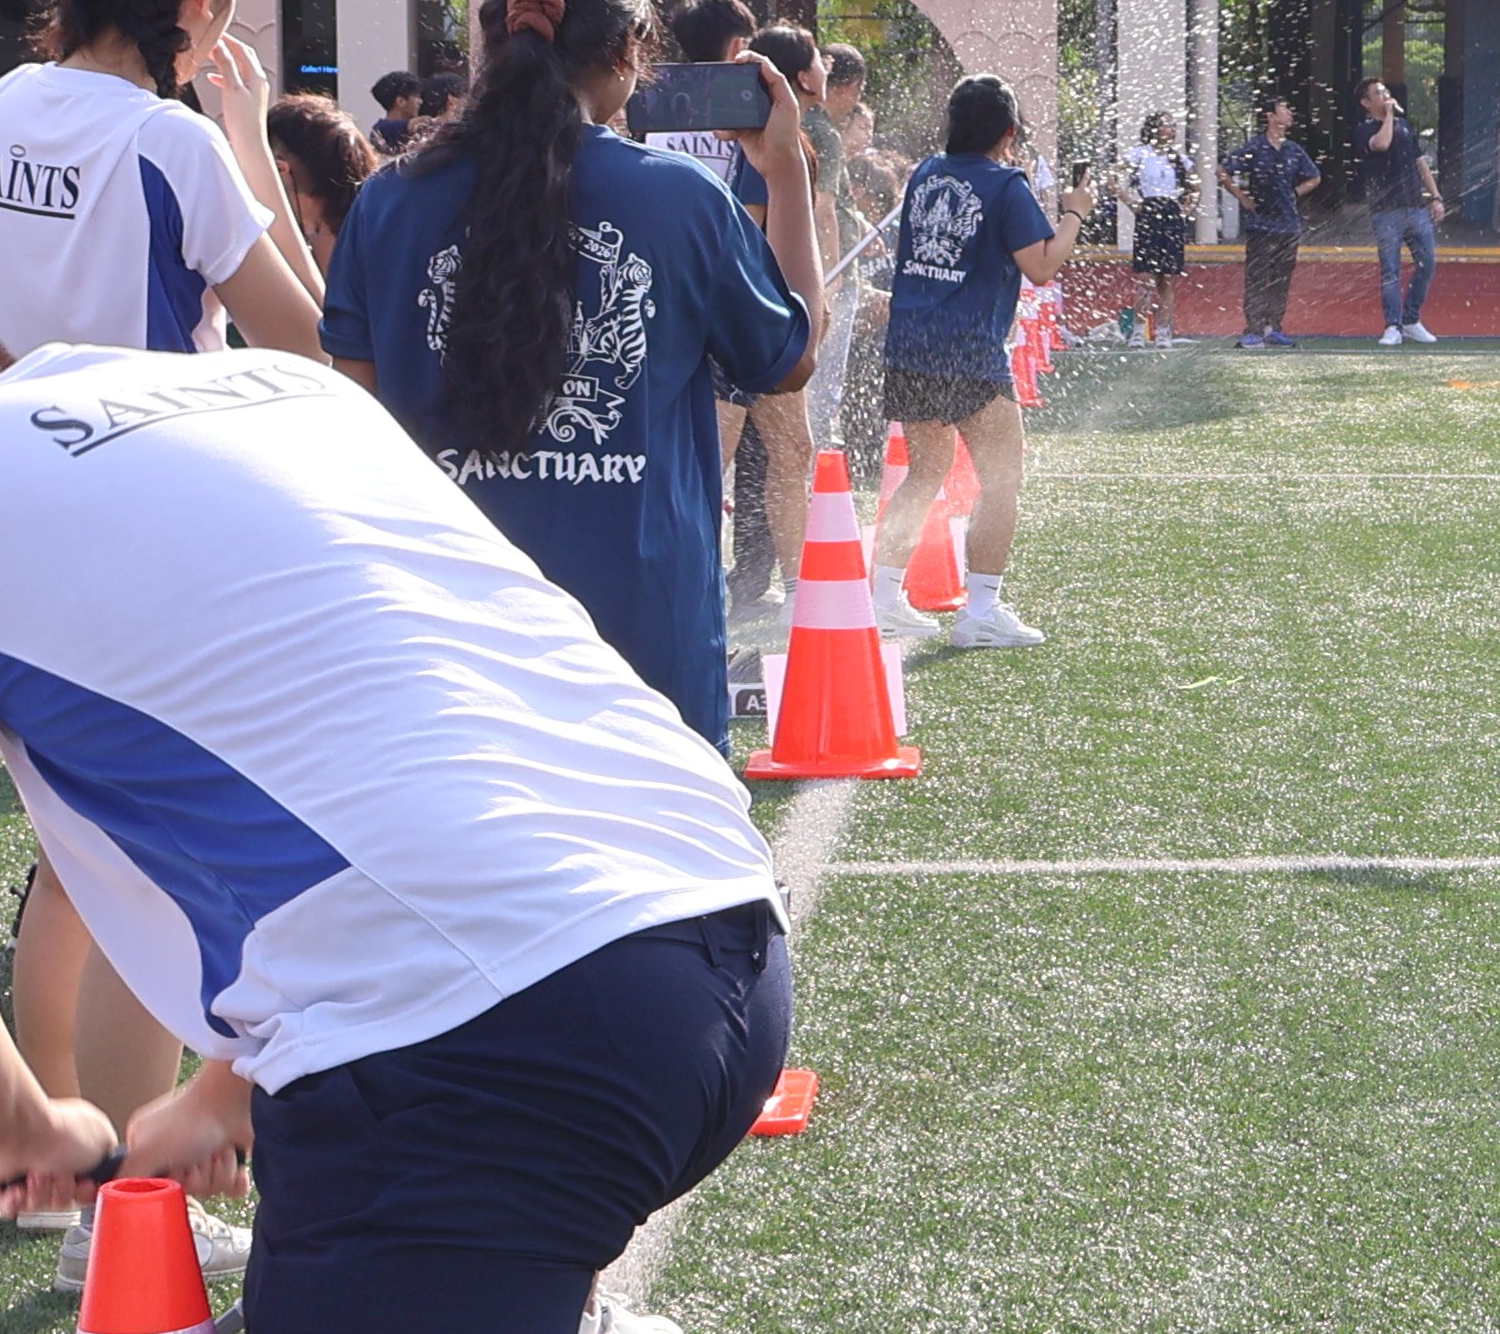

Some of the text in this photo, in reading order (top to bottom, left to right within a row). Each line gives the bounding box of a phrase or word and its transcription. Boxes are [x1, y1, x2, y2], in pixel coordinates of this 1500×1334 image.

[583, 239, 611, 258] 2026
[29, 364, 328, 450] SAINTS
[436, 448, 647, 485] SANCTUARY
